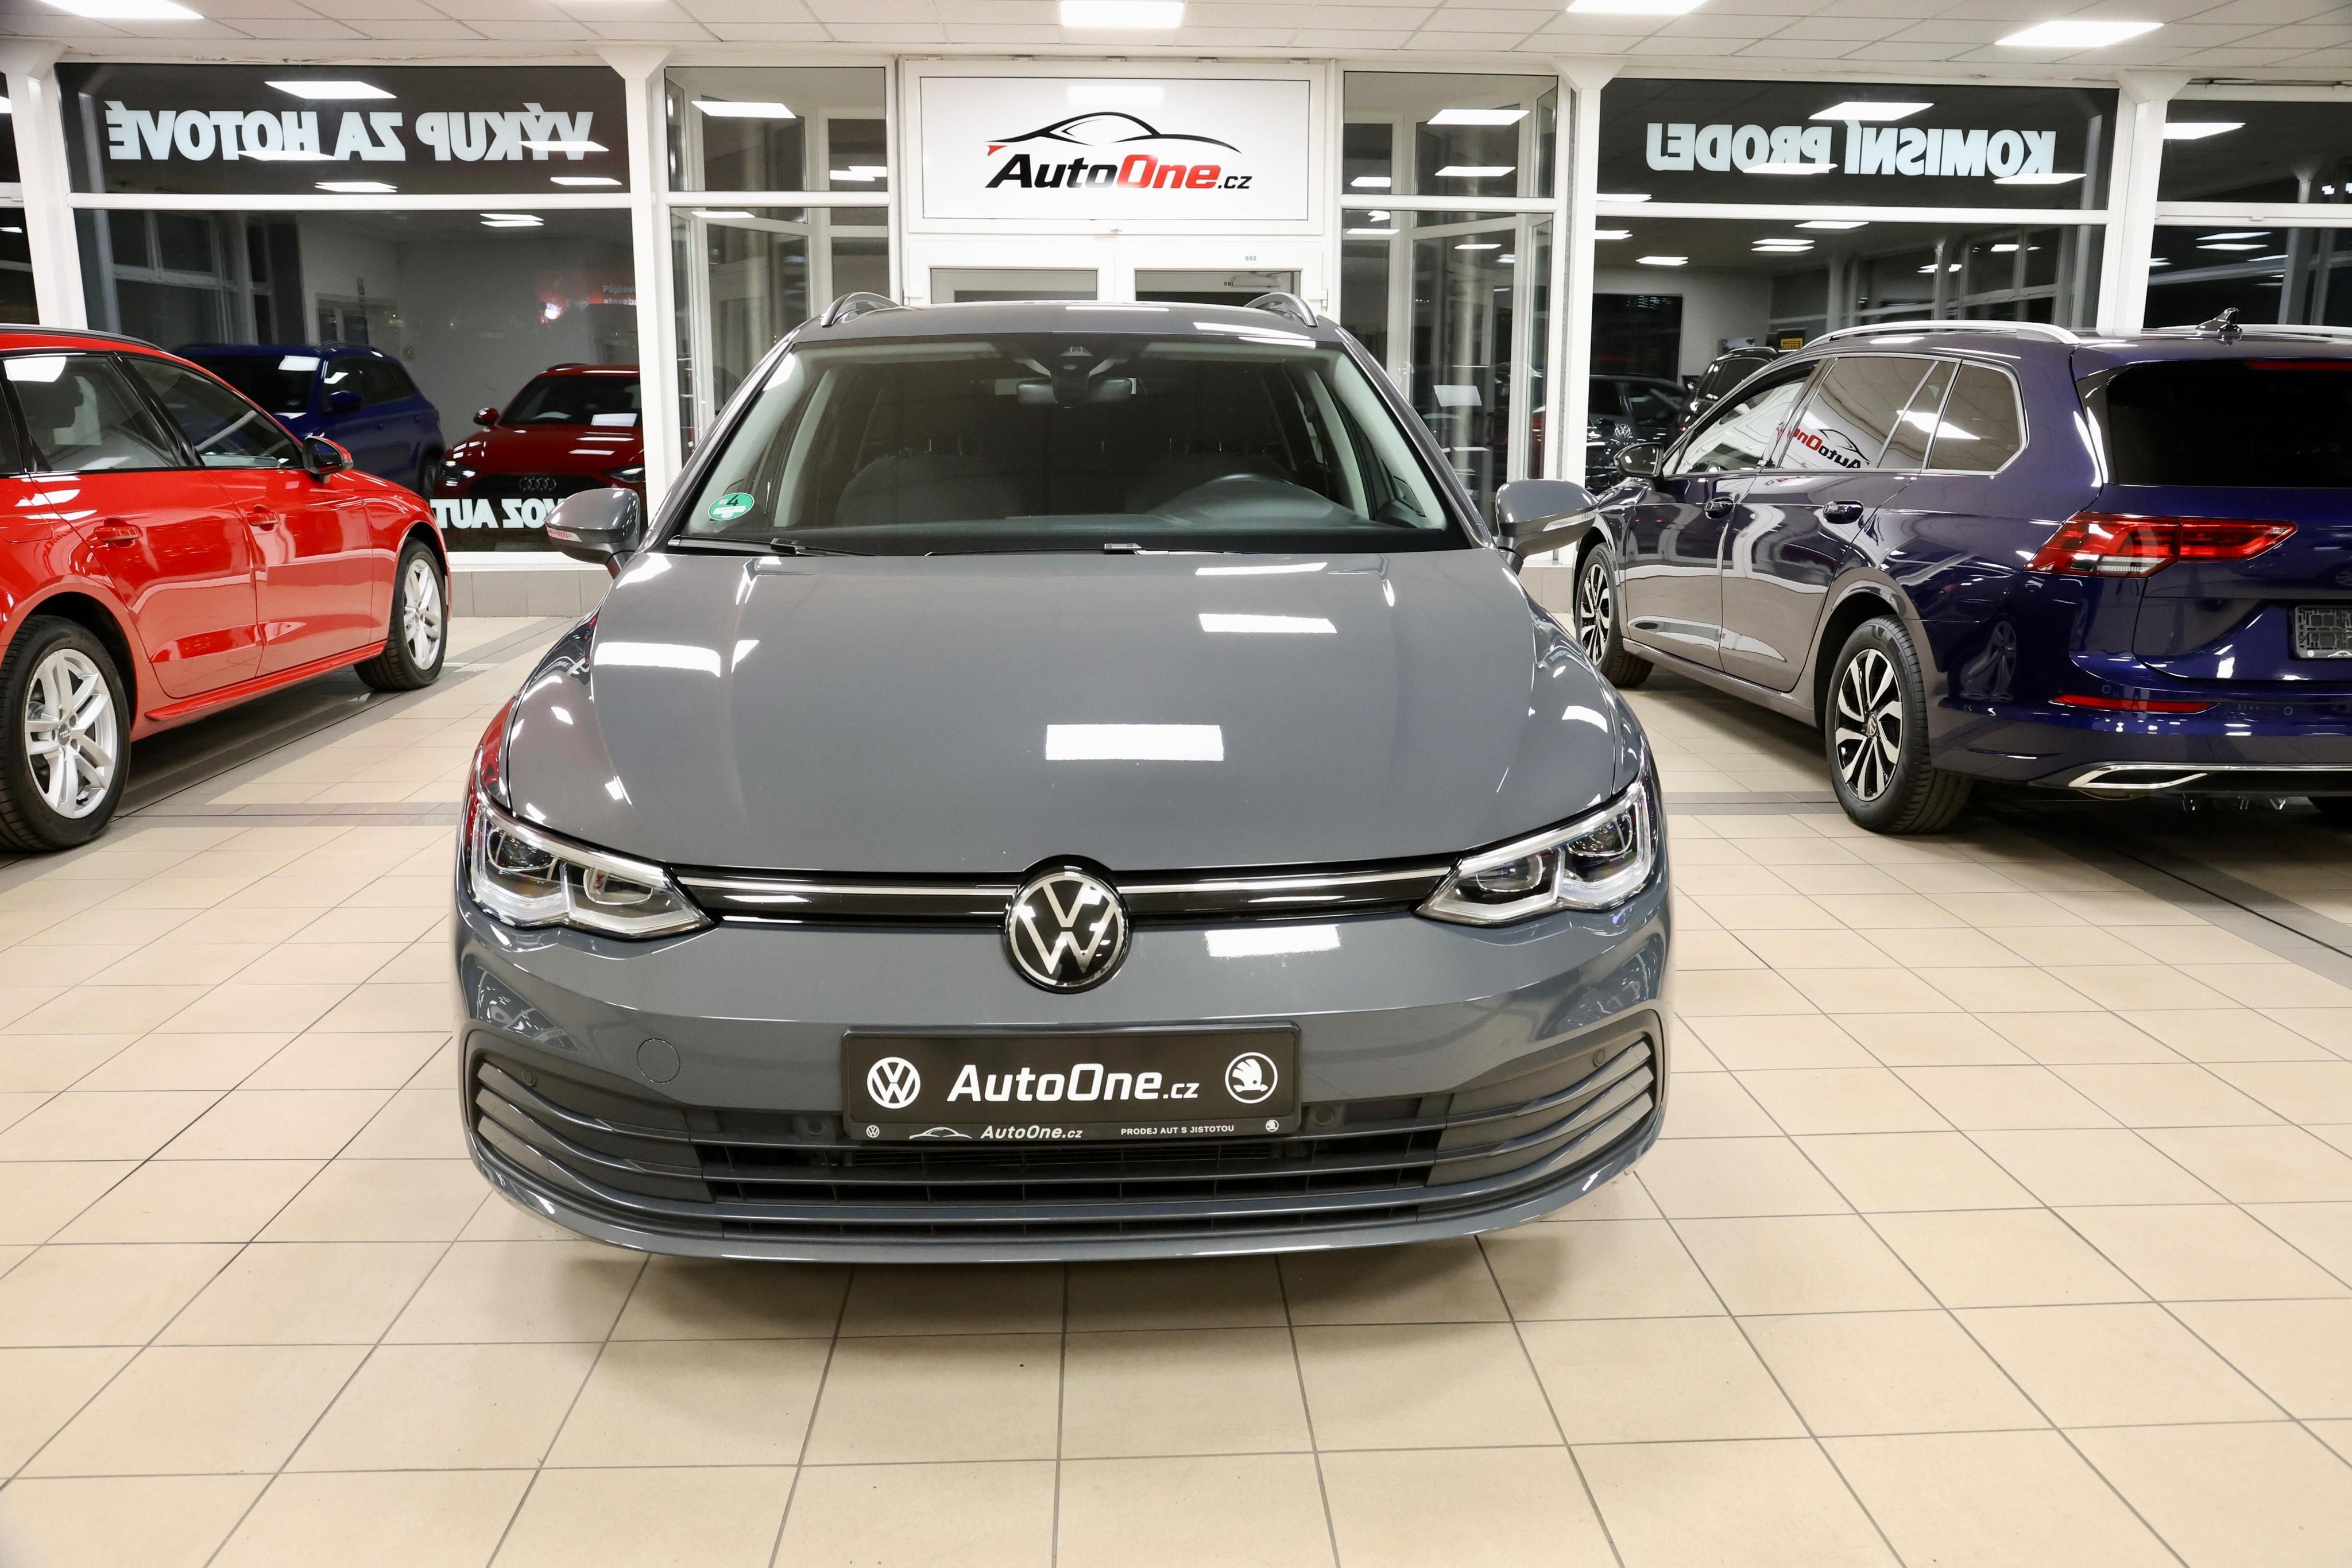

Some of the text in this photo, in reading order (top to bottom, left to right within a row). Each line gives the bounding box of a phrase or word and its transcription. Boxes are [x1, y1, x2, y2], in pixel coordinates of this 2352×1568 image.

[985, 154, 1252, 189] AutoOne.cz
[726, 494, 739, 506] 4
[947, 1063, 1200, 1102] AutoOne.cz
[980, 1125, 1083, 1139] AutoOne.cz
[1190, 1125, 1235, 1133] JISTOTOU
